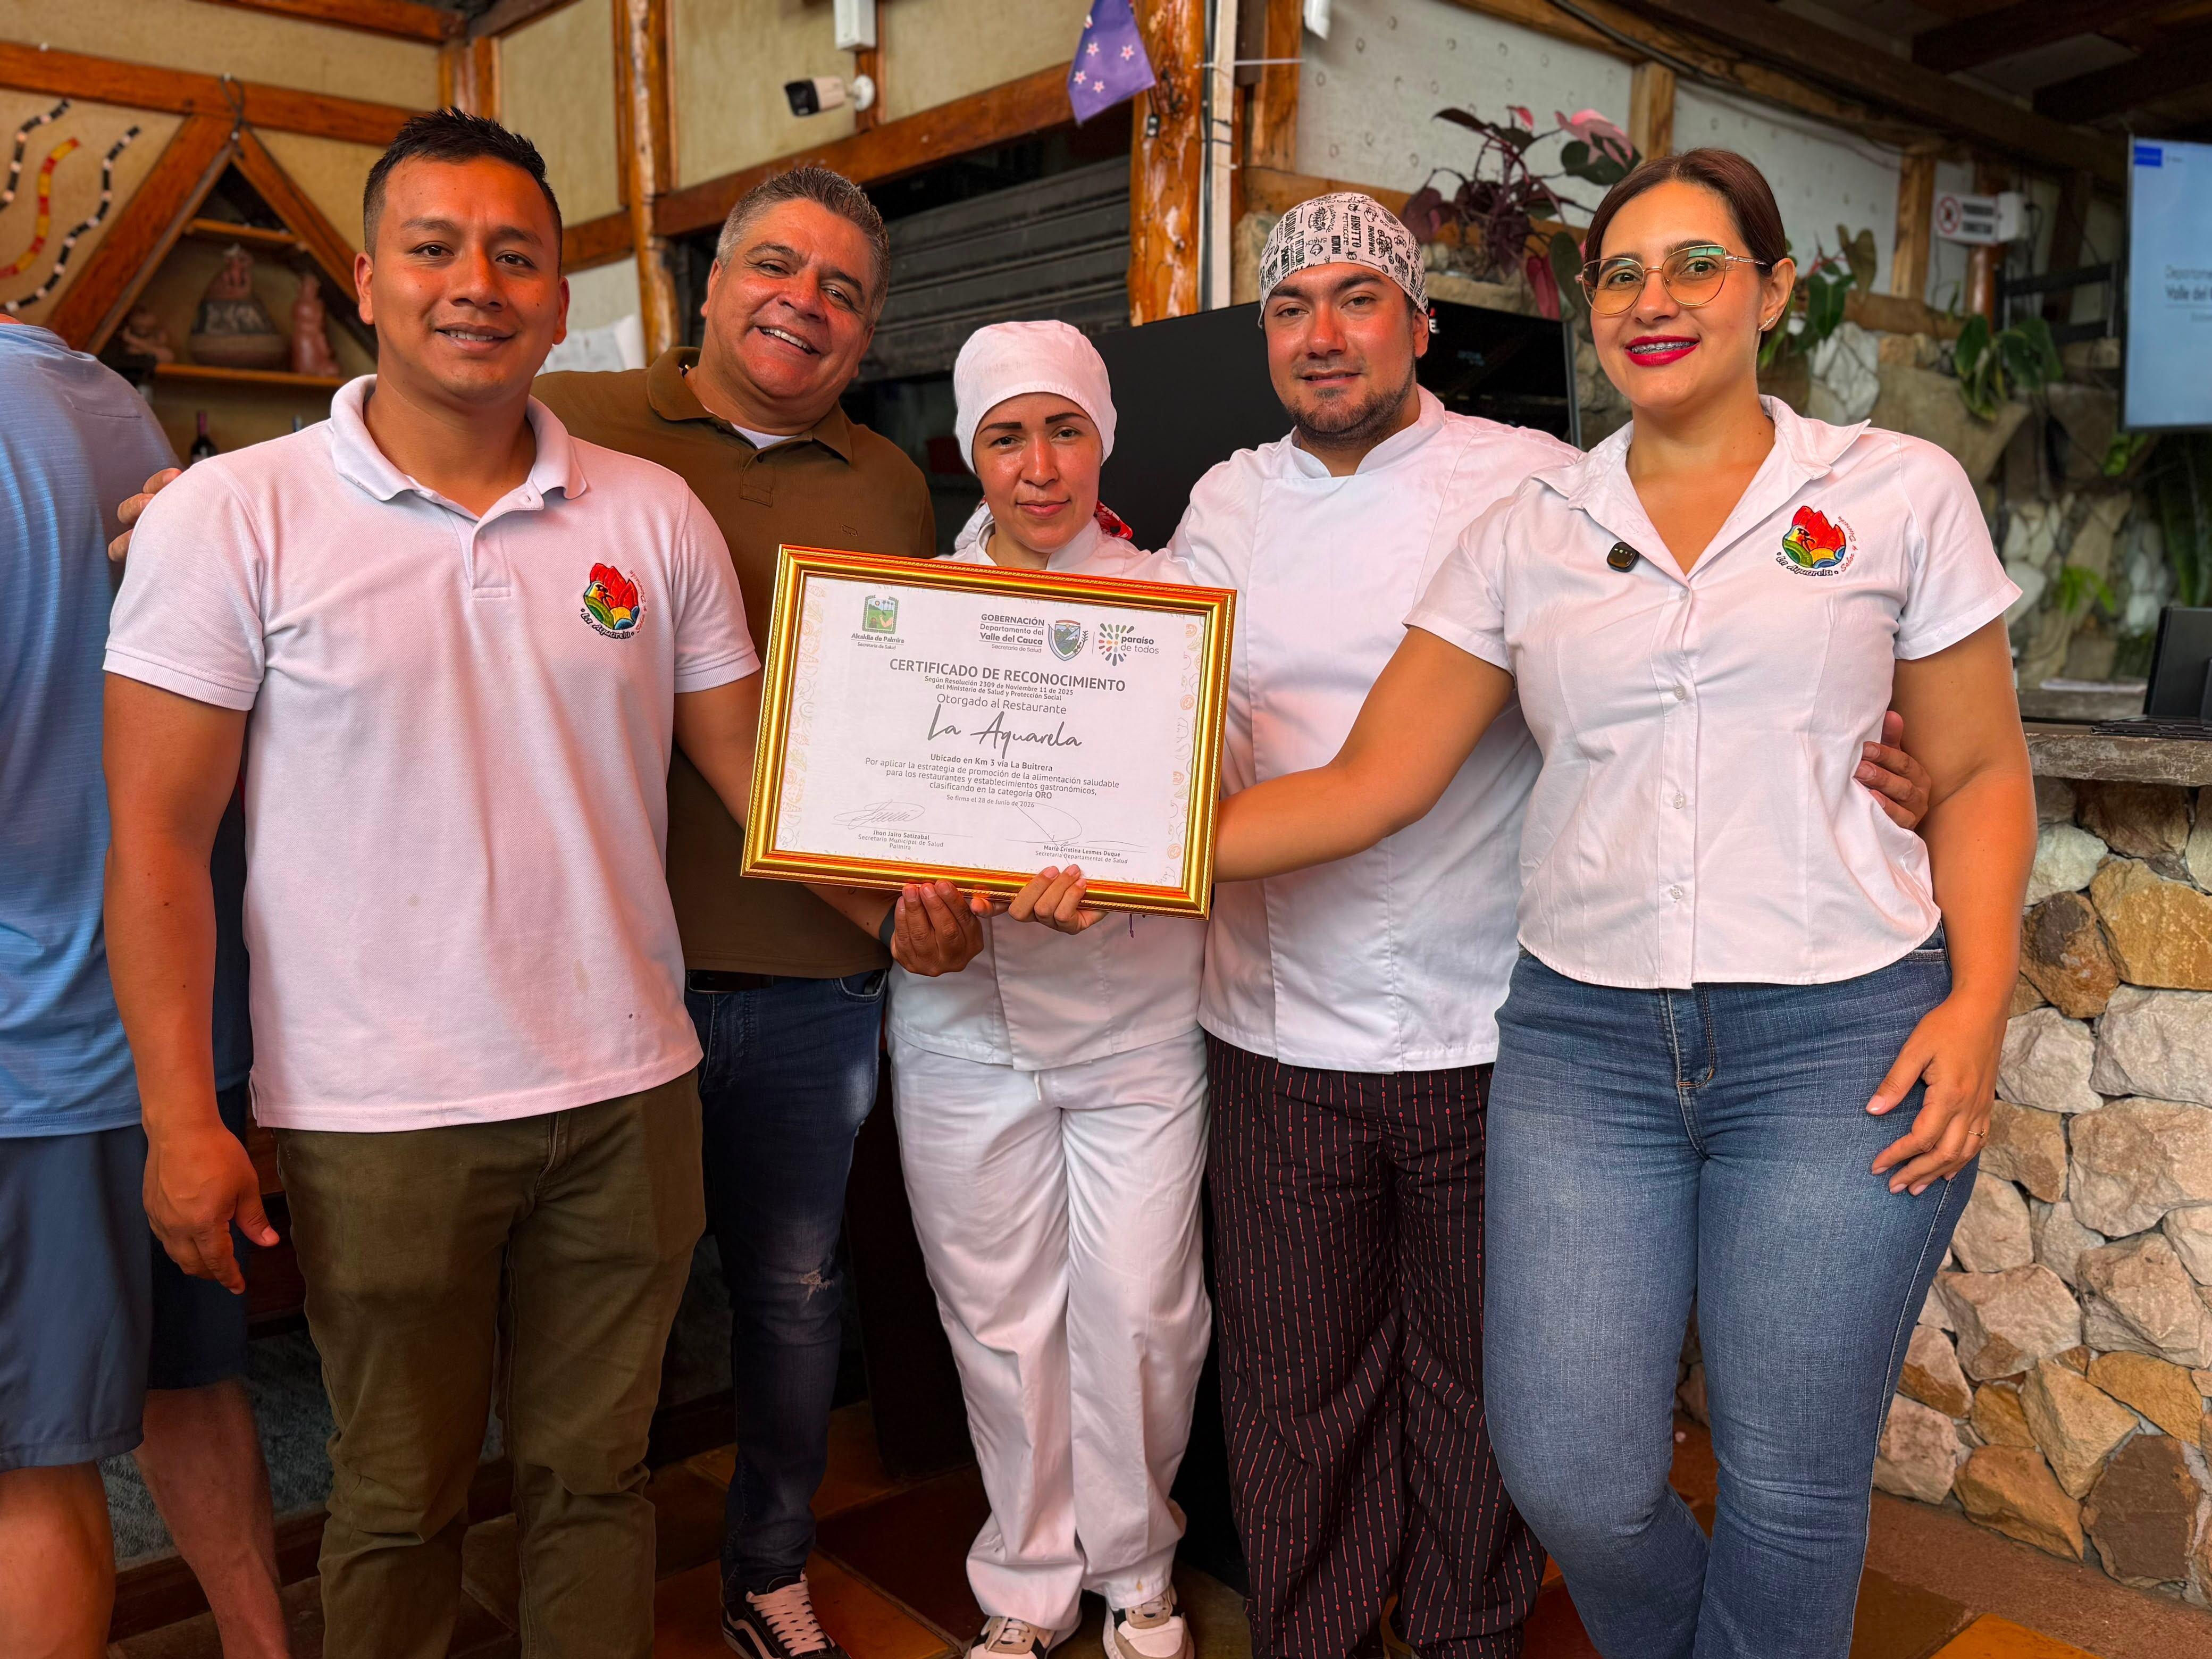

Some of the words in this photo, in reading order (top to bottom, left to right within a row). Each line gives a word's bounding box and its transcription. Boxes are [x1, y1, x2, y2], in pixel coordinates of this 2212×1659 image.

[1351, 215, 1361, 248] RISOTTO
[1368, 225, 1376, 256] POMODORI
[1776, 556, 1788, 566] La
[1787, 565, 1833, 576] Aquarela
[581, 613, 592, 624] La
[981, 614, 1044, 626] GOBERNACIÓN
[980, 623, 1031, 634] Departamento
[980, 632, 1000, 641] Valle
[1017, 636, 1043, 645] Cauca
[1121, 636, 1154, 645] paraíso
[1135, 645, 1159, 654] todos
[890, 659, 978, 677] CERTIFICADO
[983, 667, 1000, 680] DE
[1004, 669, 1125, 691] RECONOCIMIENTO
[945, 677, 977, 686] Resolución
[1006, 684, 1038, 692] Noviembre
[937, 693, 988, 707] Otorgado
[991, 699, 1000, 708] al
[1003, 700, 1067, 715] Restaurante
[927, 703, 961, 740] La
[970, 711, 1082, 759] Aquarela
[931, 753, 961, 763] Ubicado
[1022, 762, 1052, 772] Buitrera
[918, 764, 955, 774] estrategia
[969, 769, 1009, 777] promoción
[1032, 774, 1081, 784] alimentación
[1083, 778, 1119, 788] saludable
[919, 773, 965, 782] restaurantes
[974, 778, 1038, 789] establecimientos
[1040, 784, 1096, 795] gastronómicos,
[929, 782, 974, 792] clasificando
[998, 788, 1033, 798] categoría
